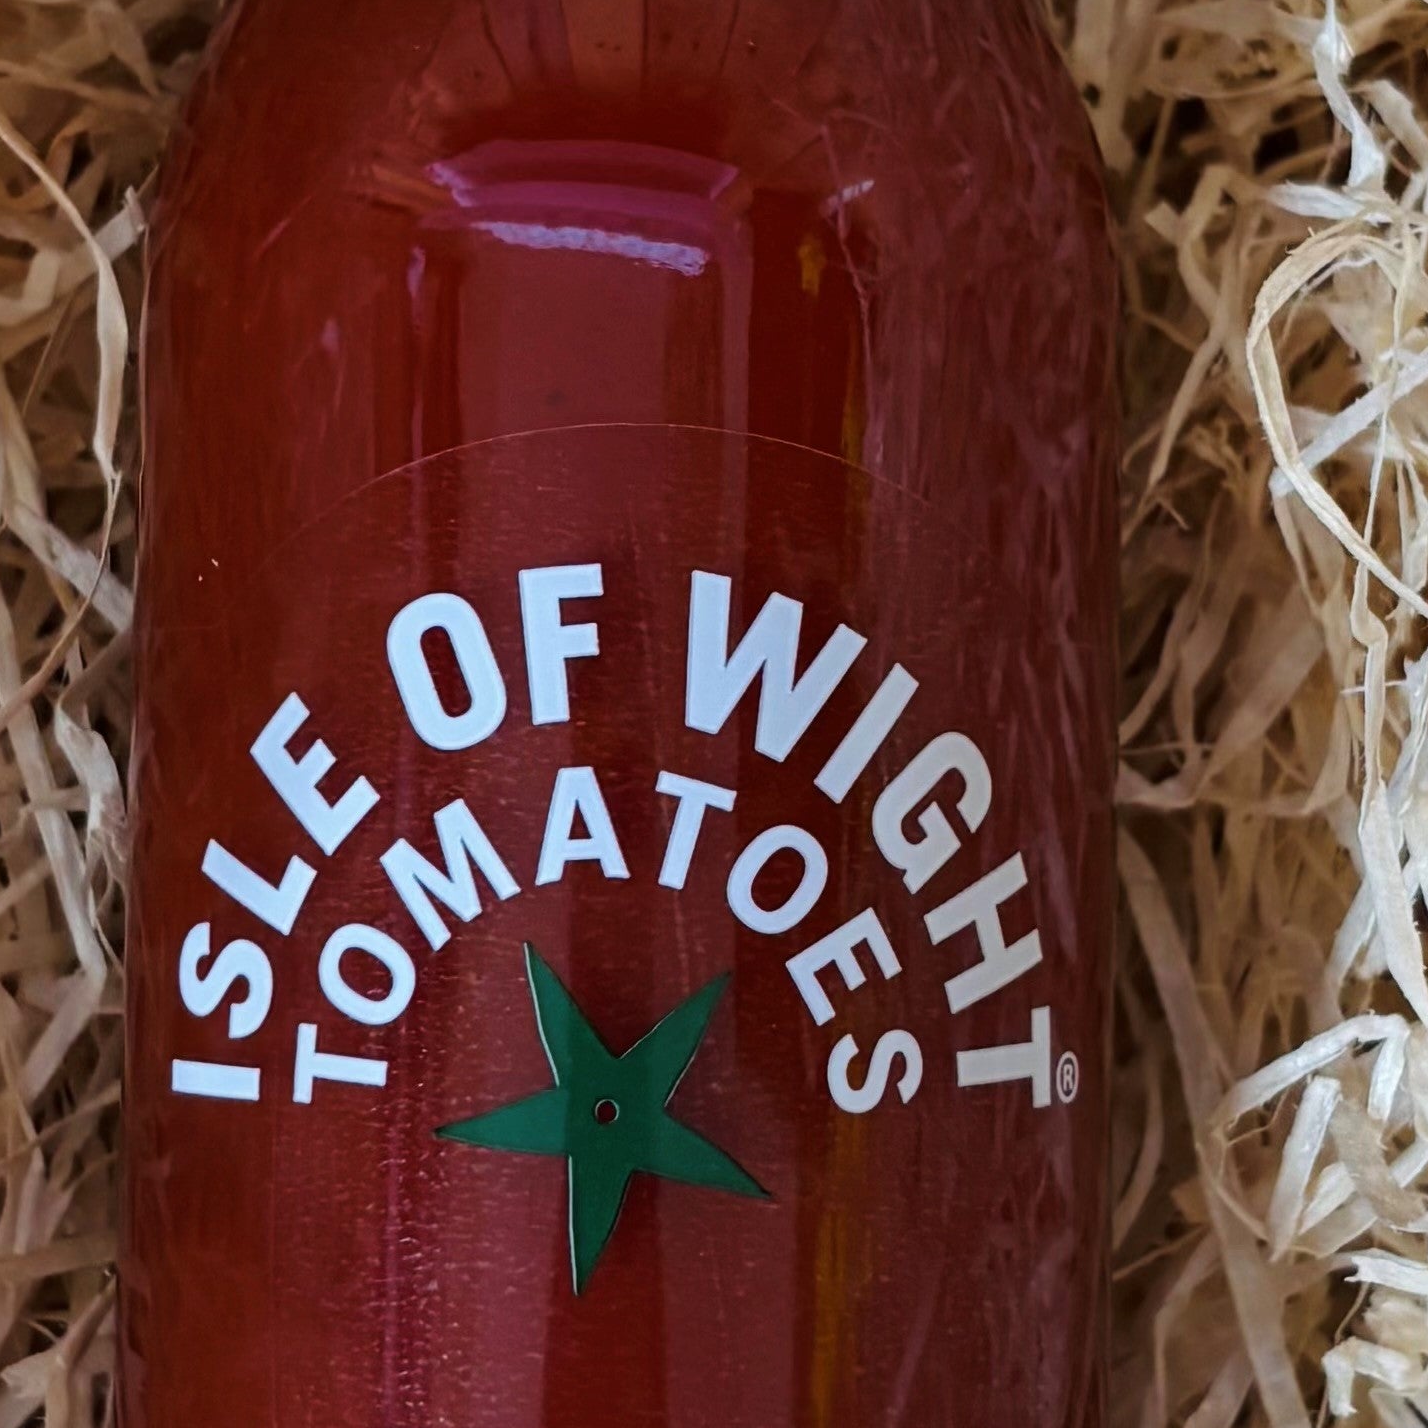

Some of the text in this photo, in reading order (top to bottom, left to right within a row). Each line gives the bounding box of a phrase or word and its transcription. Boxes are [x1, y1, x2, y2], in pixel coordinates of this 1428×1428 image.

[171, 691, 379, 1101] ISLE
[386, 563, 604, 751] OF
[293, 766, 923, 1114] TOMATOES
